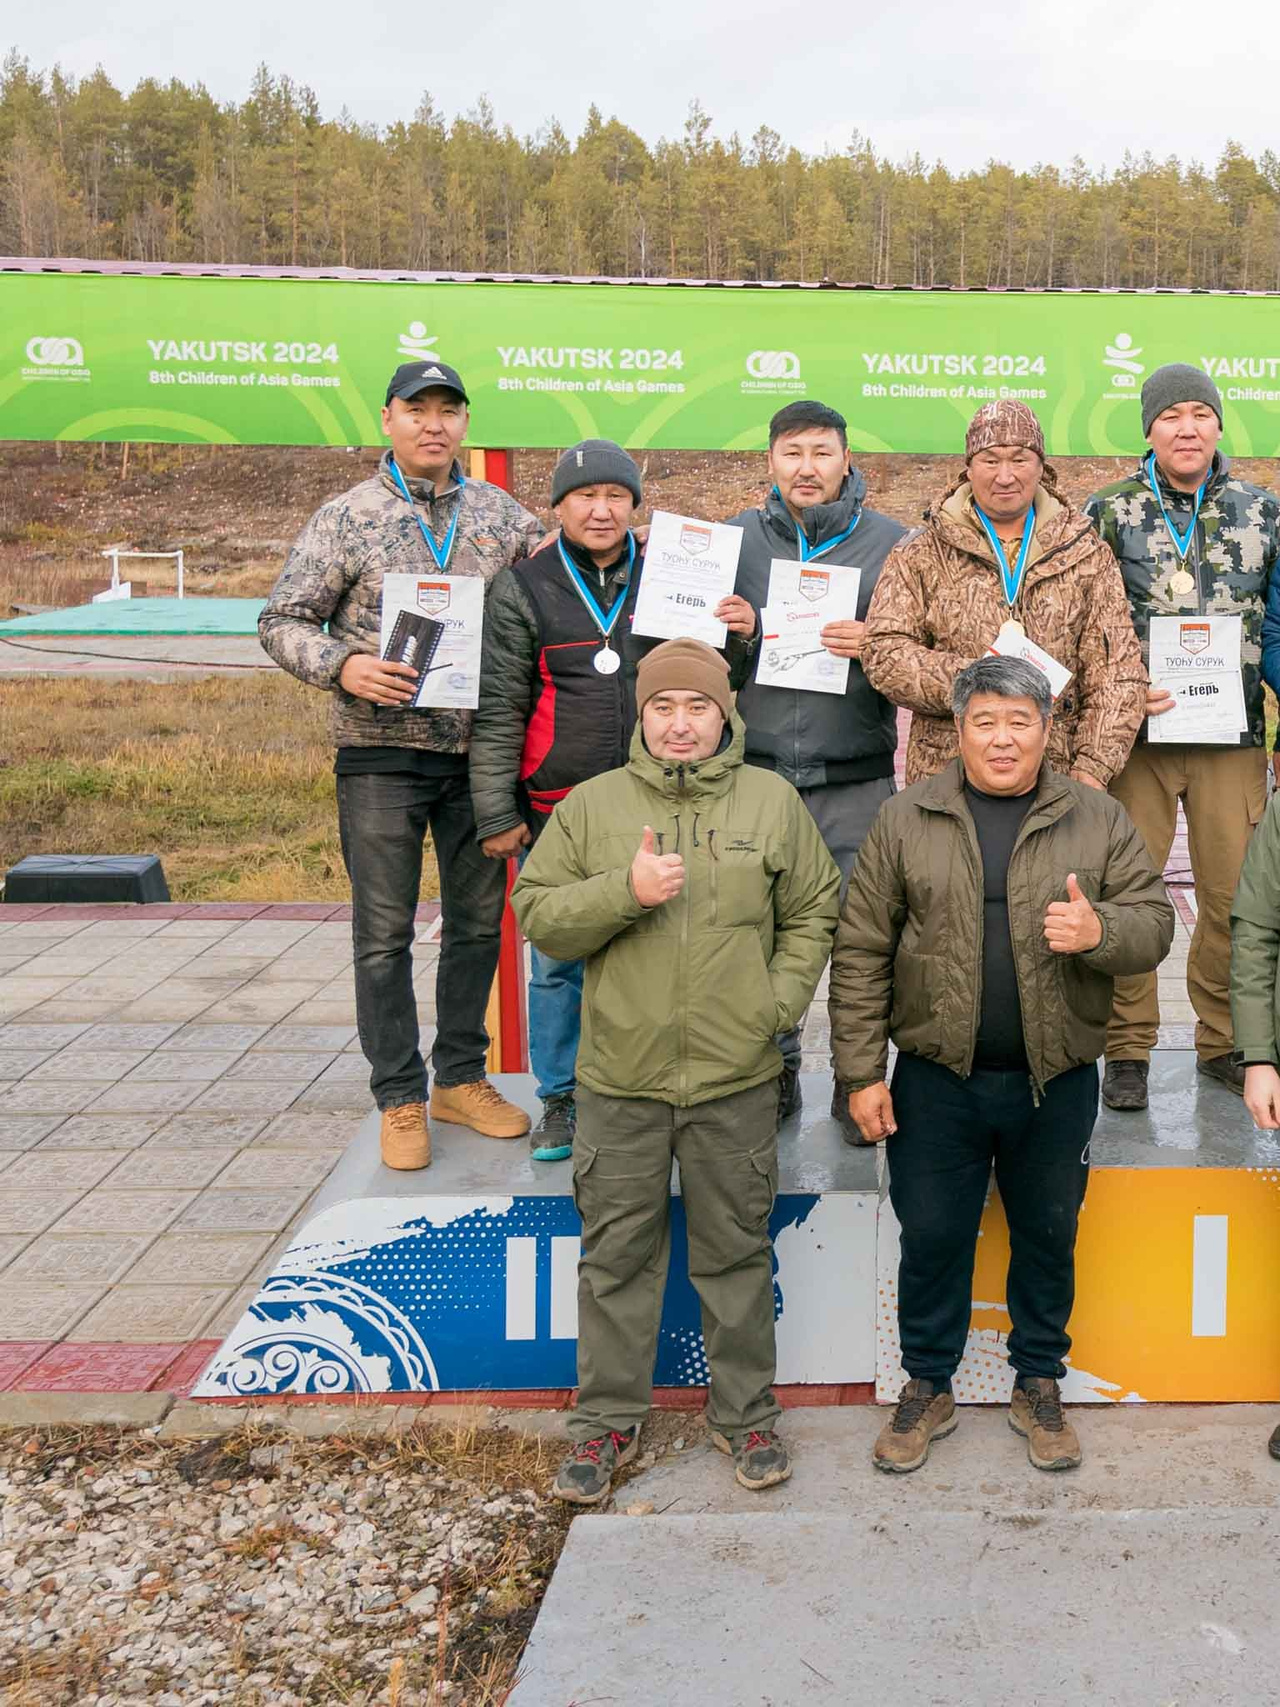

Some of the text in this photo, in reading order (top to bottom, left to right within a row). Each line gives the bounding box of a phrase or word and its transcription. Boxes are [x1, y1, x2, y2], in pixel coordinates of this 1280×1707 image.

[147, 340, 339, 364] YAKUTSK 2024
[497, 347, 684, 370] YAKUTSK 2024
[862, 354, 1047, 376] YAKUTSK 2024
[149, 371, 340, 387] 8th Children of Asia Games
[498, 378, 685, 393] 8th Children of Asia Games
[862, 384, 1047, 399] 8th Children of Asia Games
[675, 593, 706, 607] Егерь
[1188, 684, 1220, 696] Егерь
